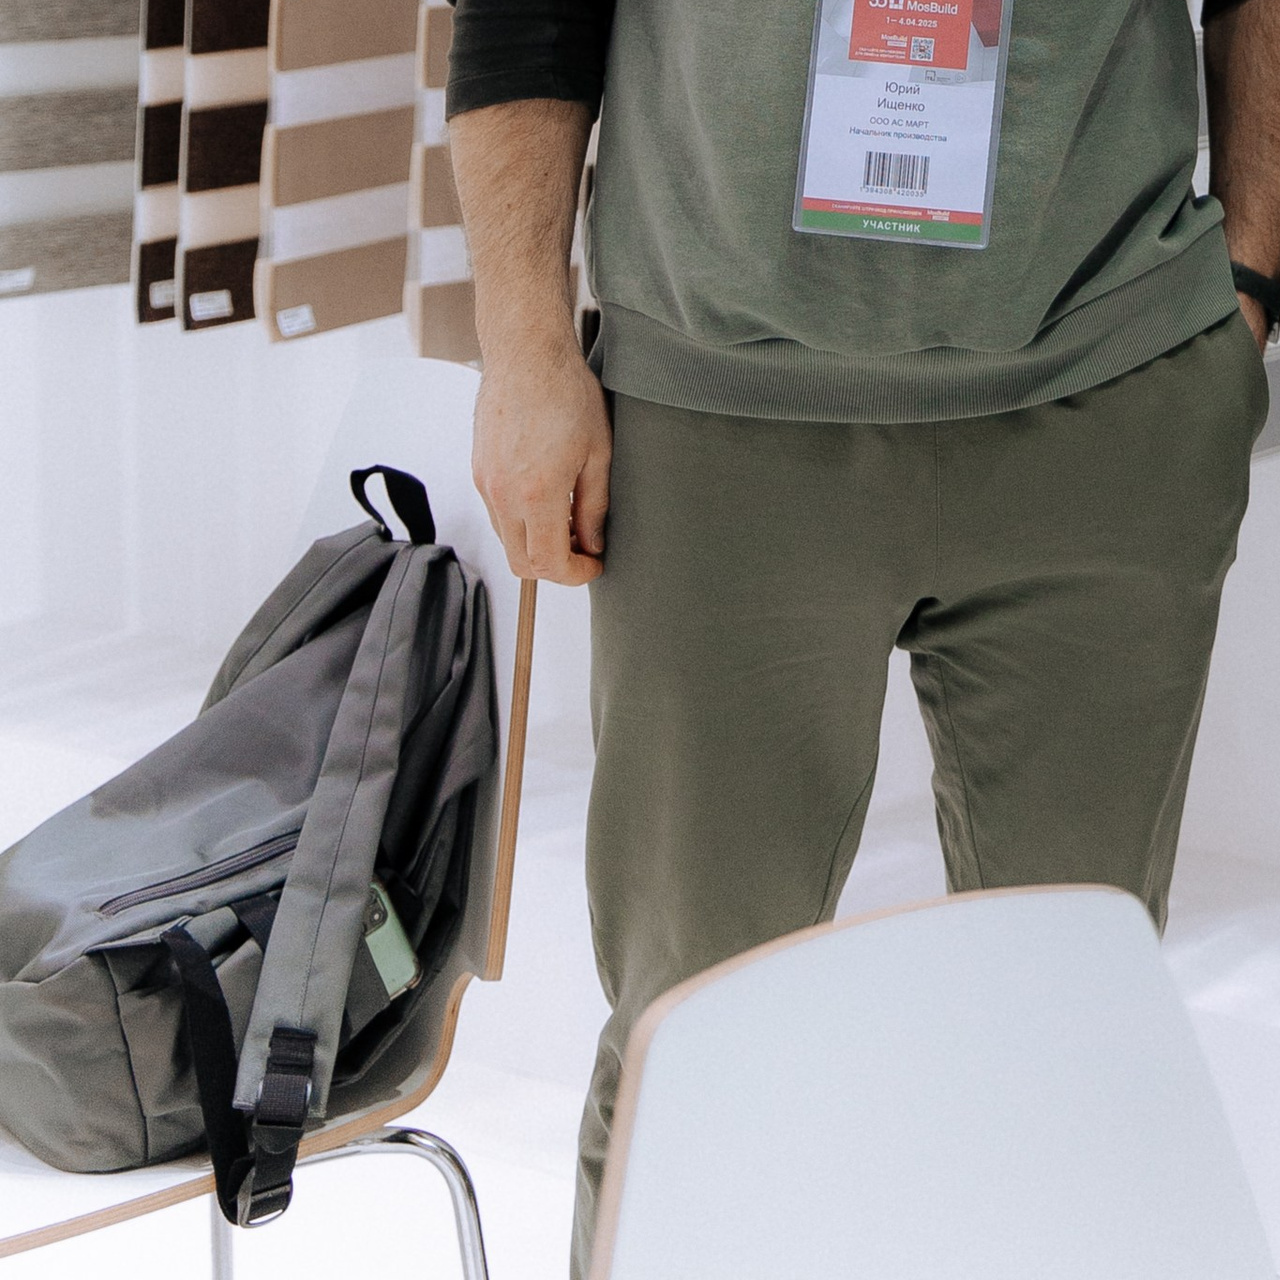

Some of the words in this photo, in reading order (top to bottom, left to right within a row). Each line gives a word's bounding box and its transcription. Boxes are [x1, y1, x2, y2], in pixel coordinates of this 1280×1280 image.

[907, 0, 958, 15] MosBuild
[898, 18, 938, 28] 4.04.2025
[885, 81, 920, 96] Юрий
[877, 98, 926, 112] Ищенко
[905, 120, 930, 129] МАРТ
[849, 126, 892, 138] Начальник
[893, 130, 948, 142] производства
[863, 219, 921, 233] УЧАСТНИК
